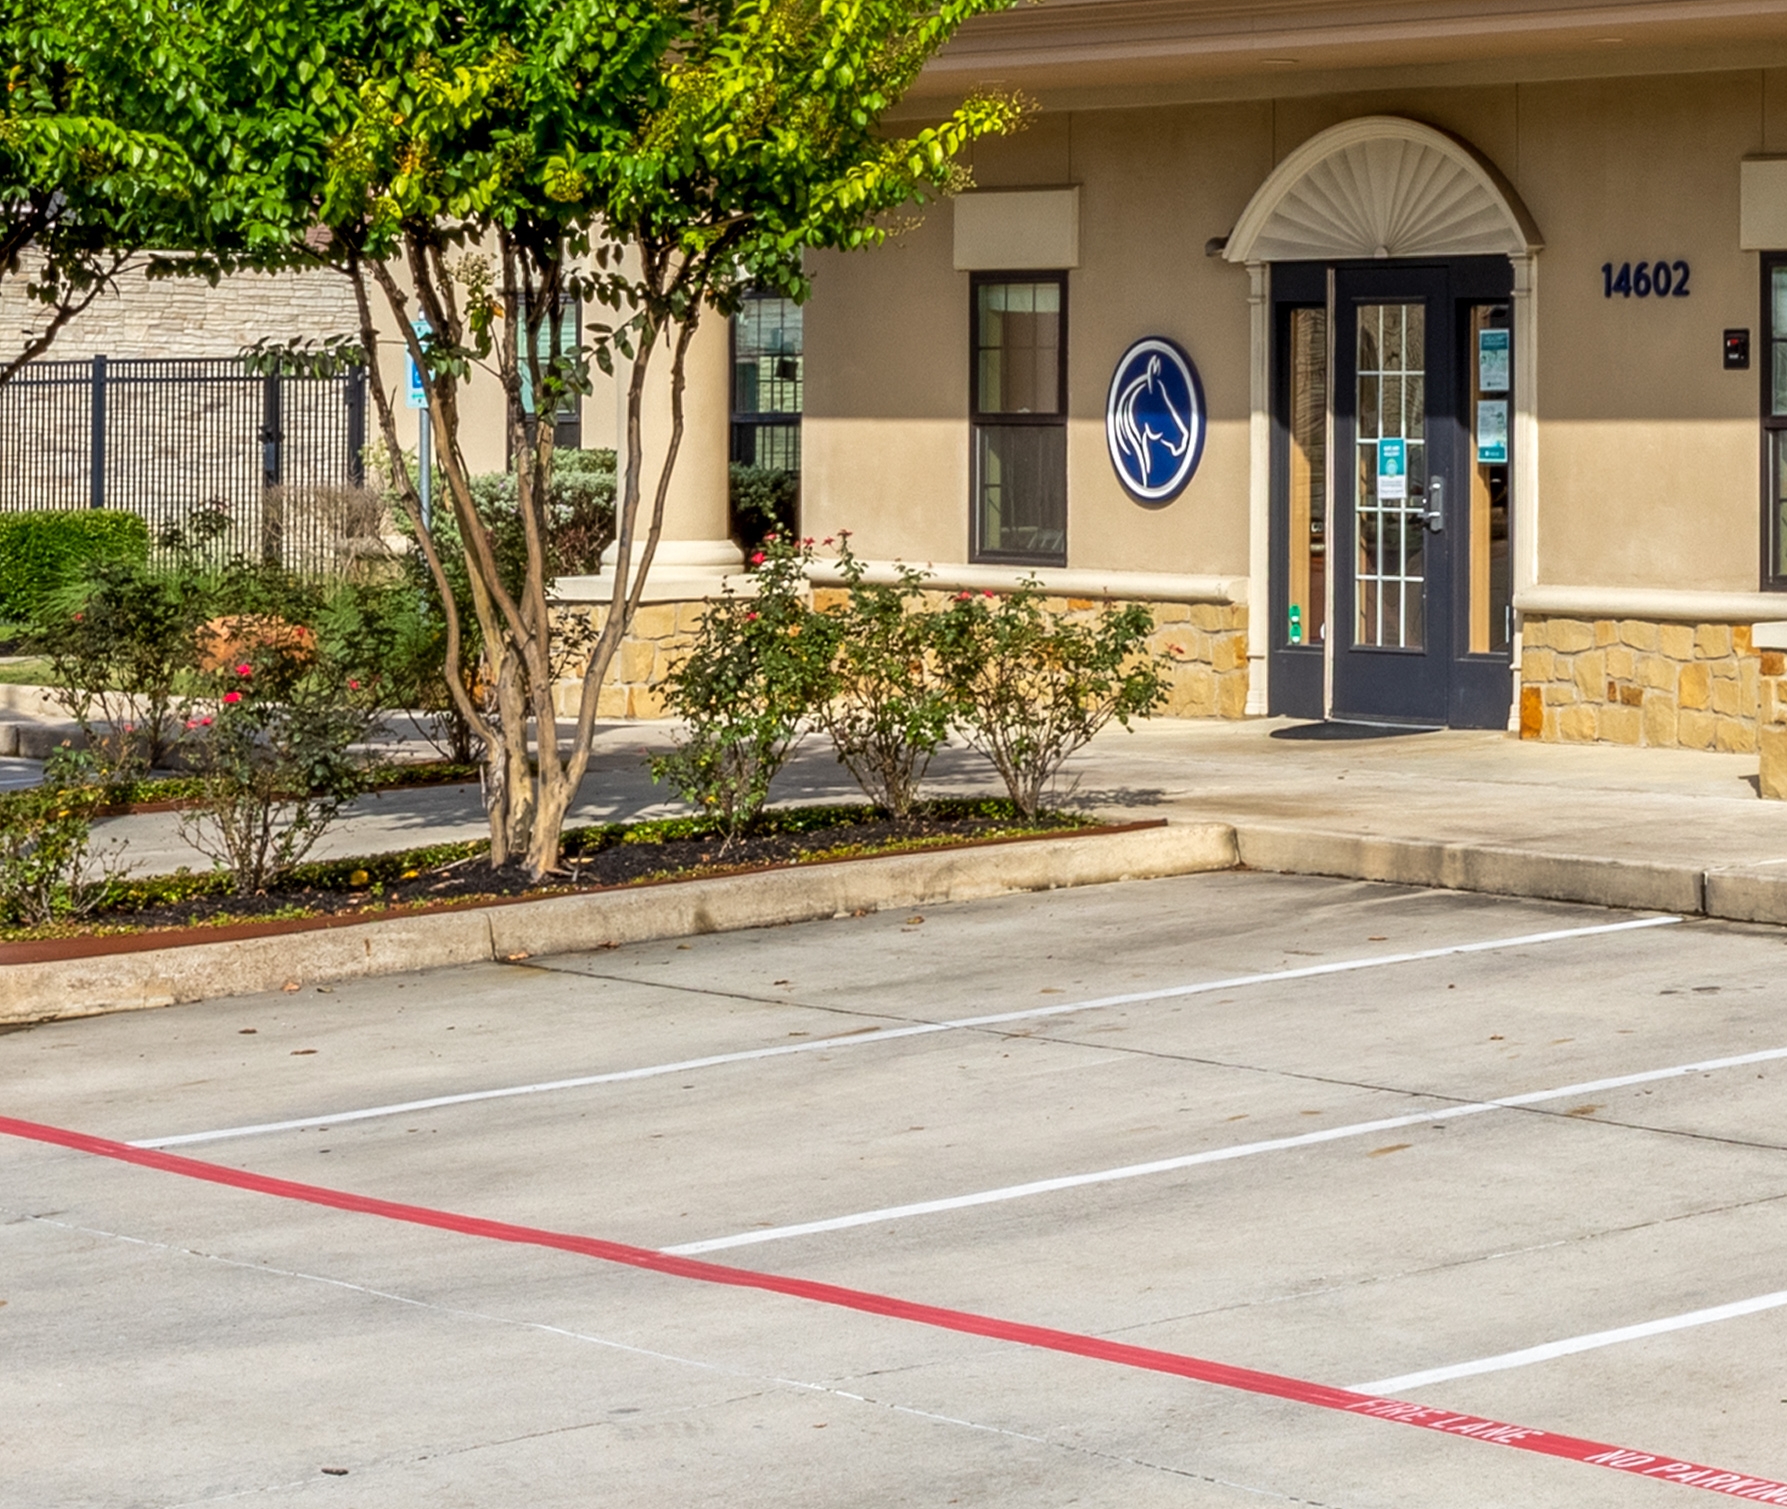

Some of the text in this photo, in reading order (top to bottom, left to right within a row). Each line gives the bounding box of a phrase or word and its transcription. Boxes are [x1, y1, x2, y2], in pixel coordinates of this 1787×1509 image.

[1601, 260, 1690, 298] 14602
[1344, 1398, 1447, 1422] FIRE
[1428, 1416, 1545, 1444] LANE
[1583, 1449, 1656, 1468] NO
